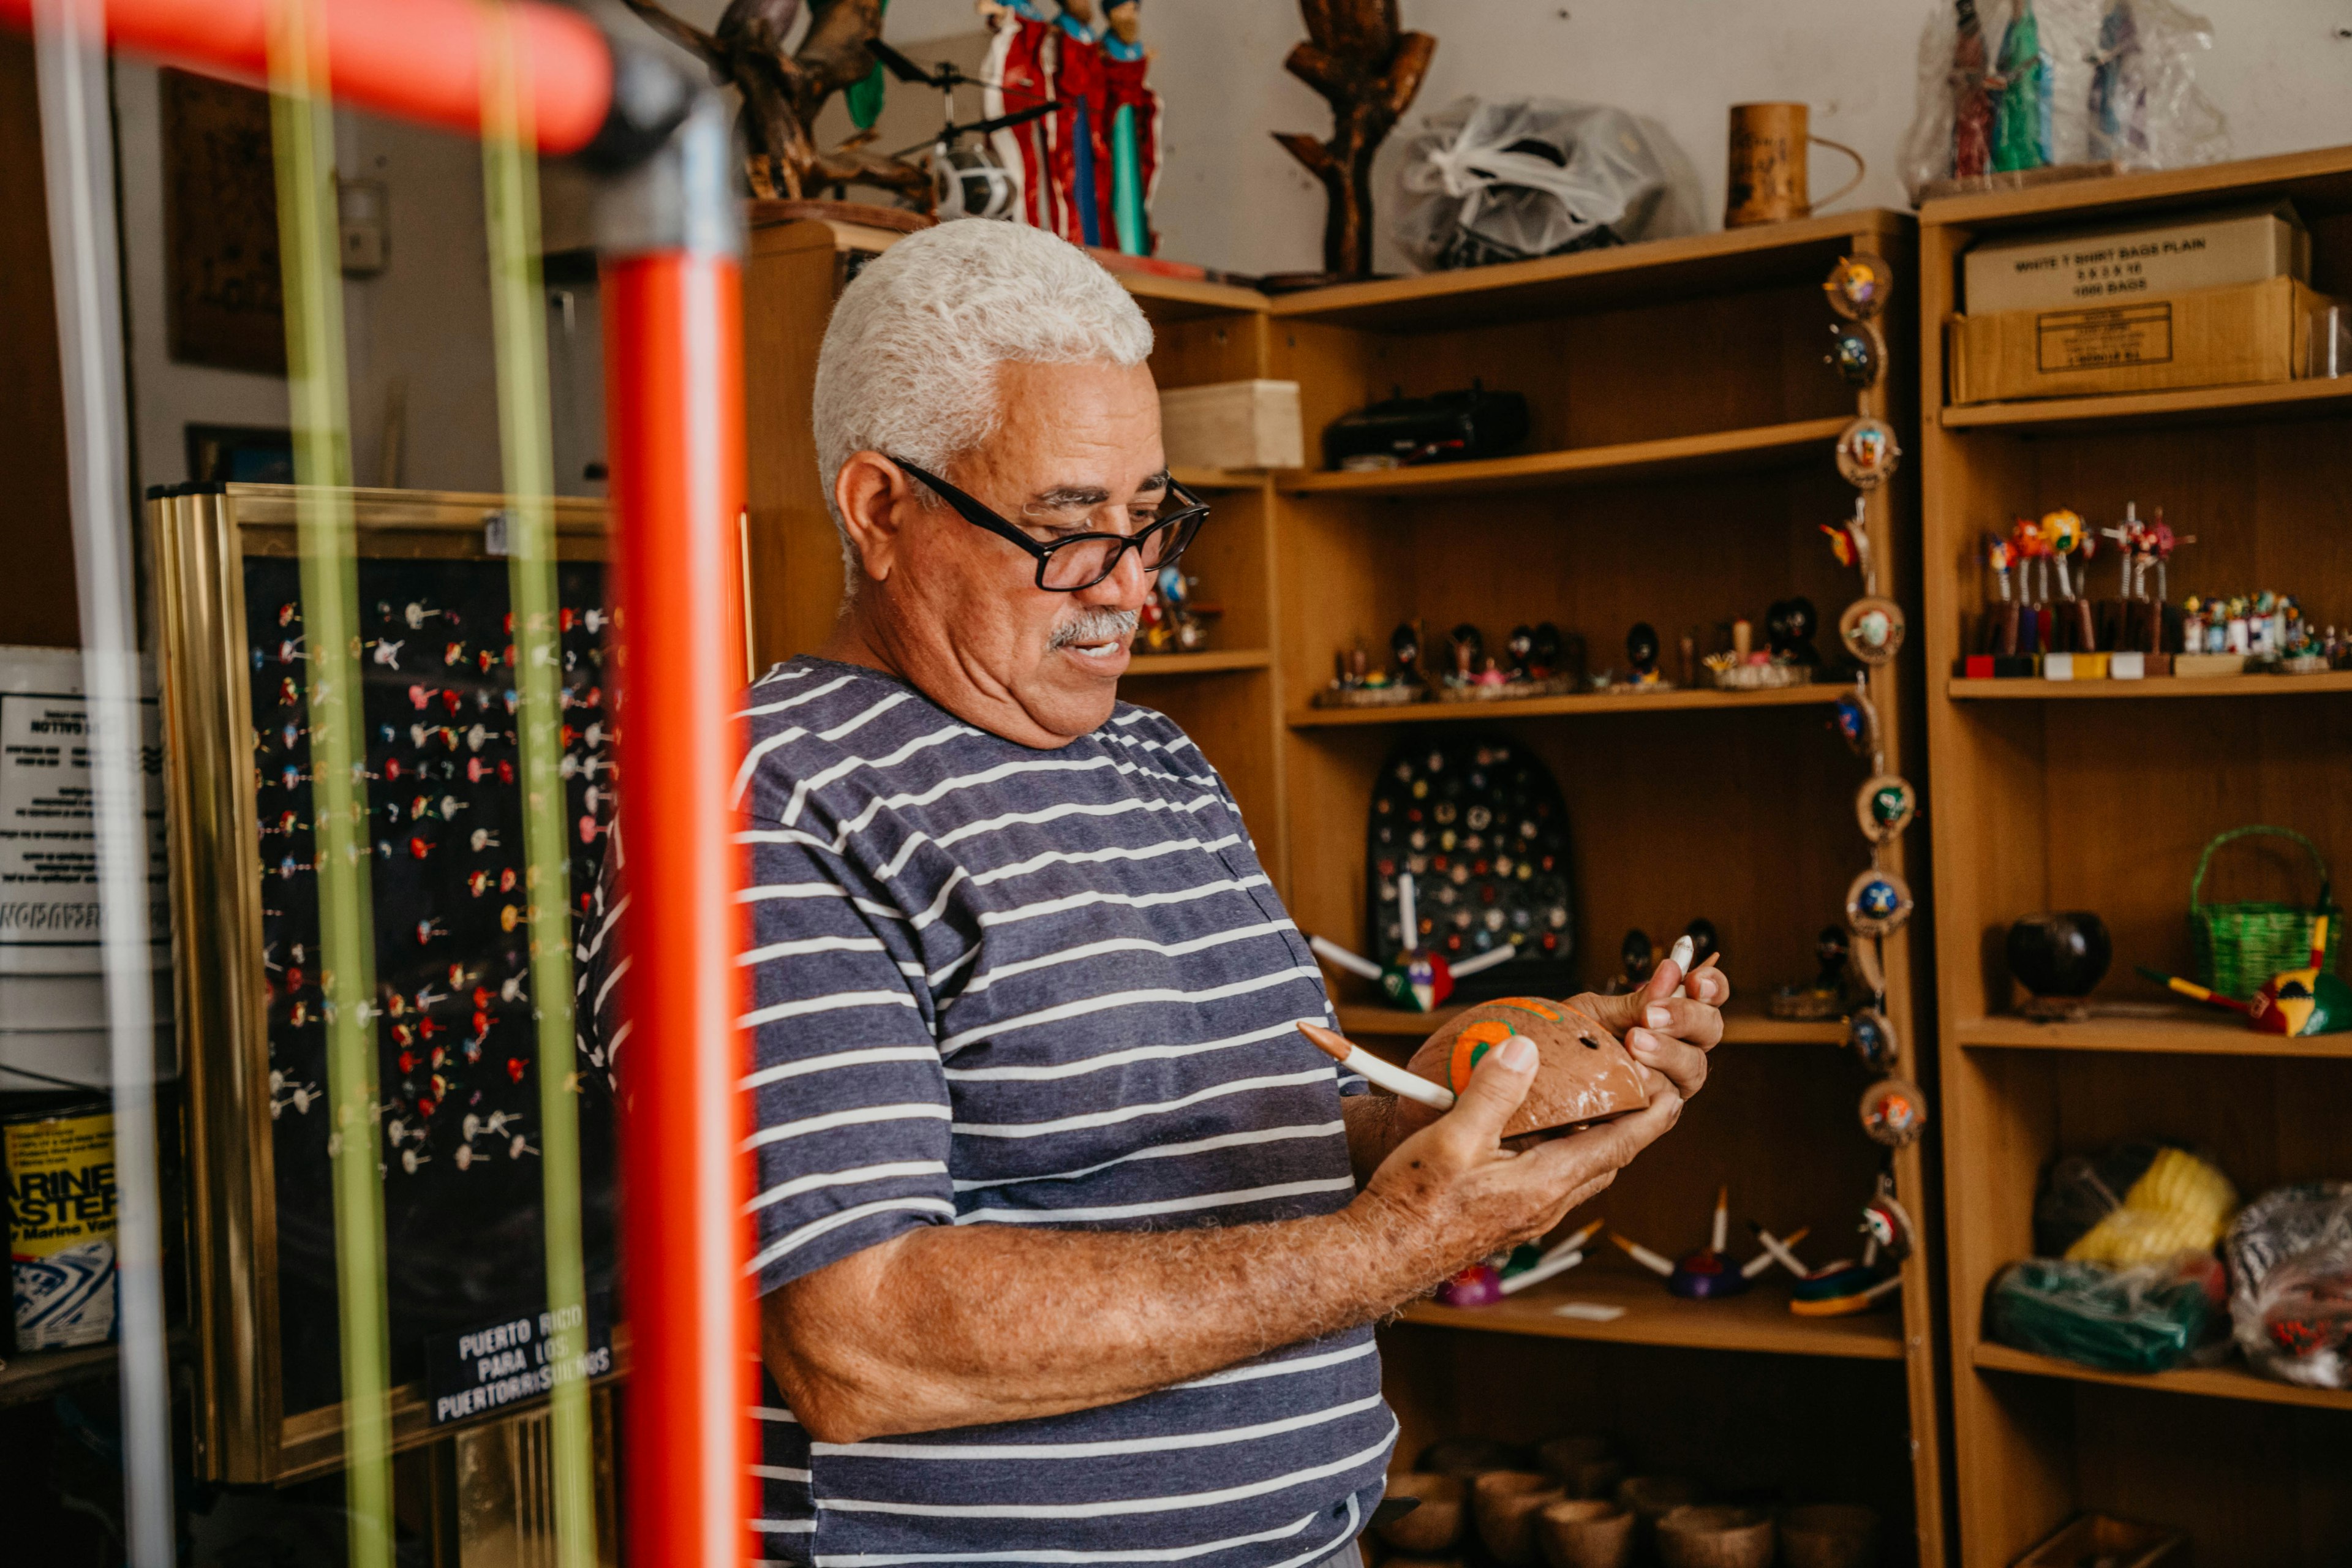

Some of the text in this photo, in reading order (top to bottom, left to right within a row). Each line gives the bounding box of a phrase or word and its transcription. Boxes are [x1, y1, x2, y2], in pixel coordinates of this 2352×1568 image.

[2015, 238, 2205, 272] WHITE T SHIRT BAGS PLAIN
[2107, 278, 2146, 294] BAGS
[23, 1226, 81, 1240] Marine
[459, 1304, 582, 1360] PUERTO RICO
[477, 1335, 568, 1382] PARA LOS
